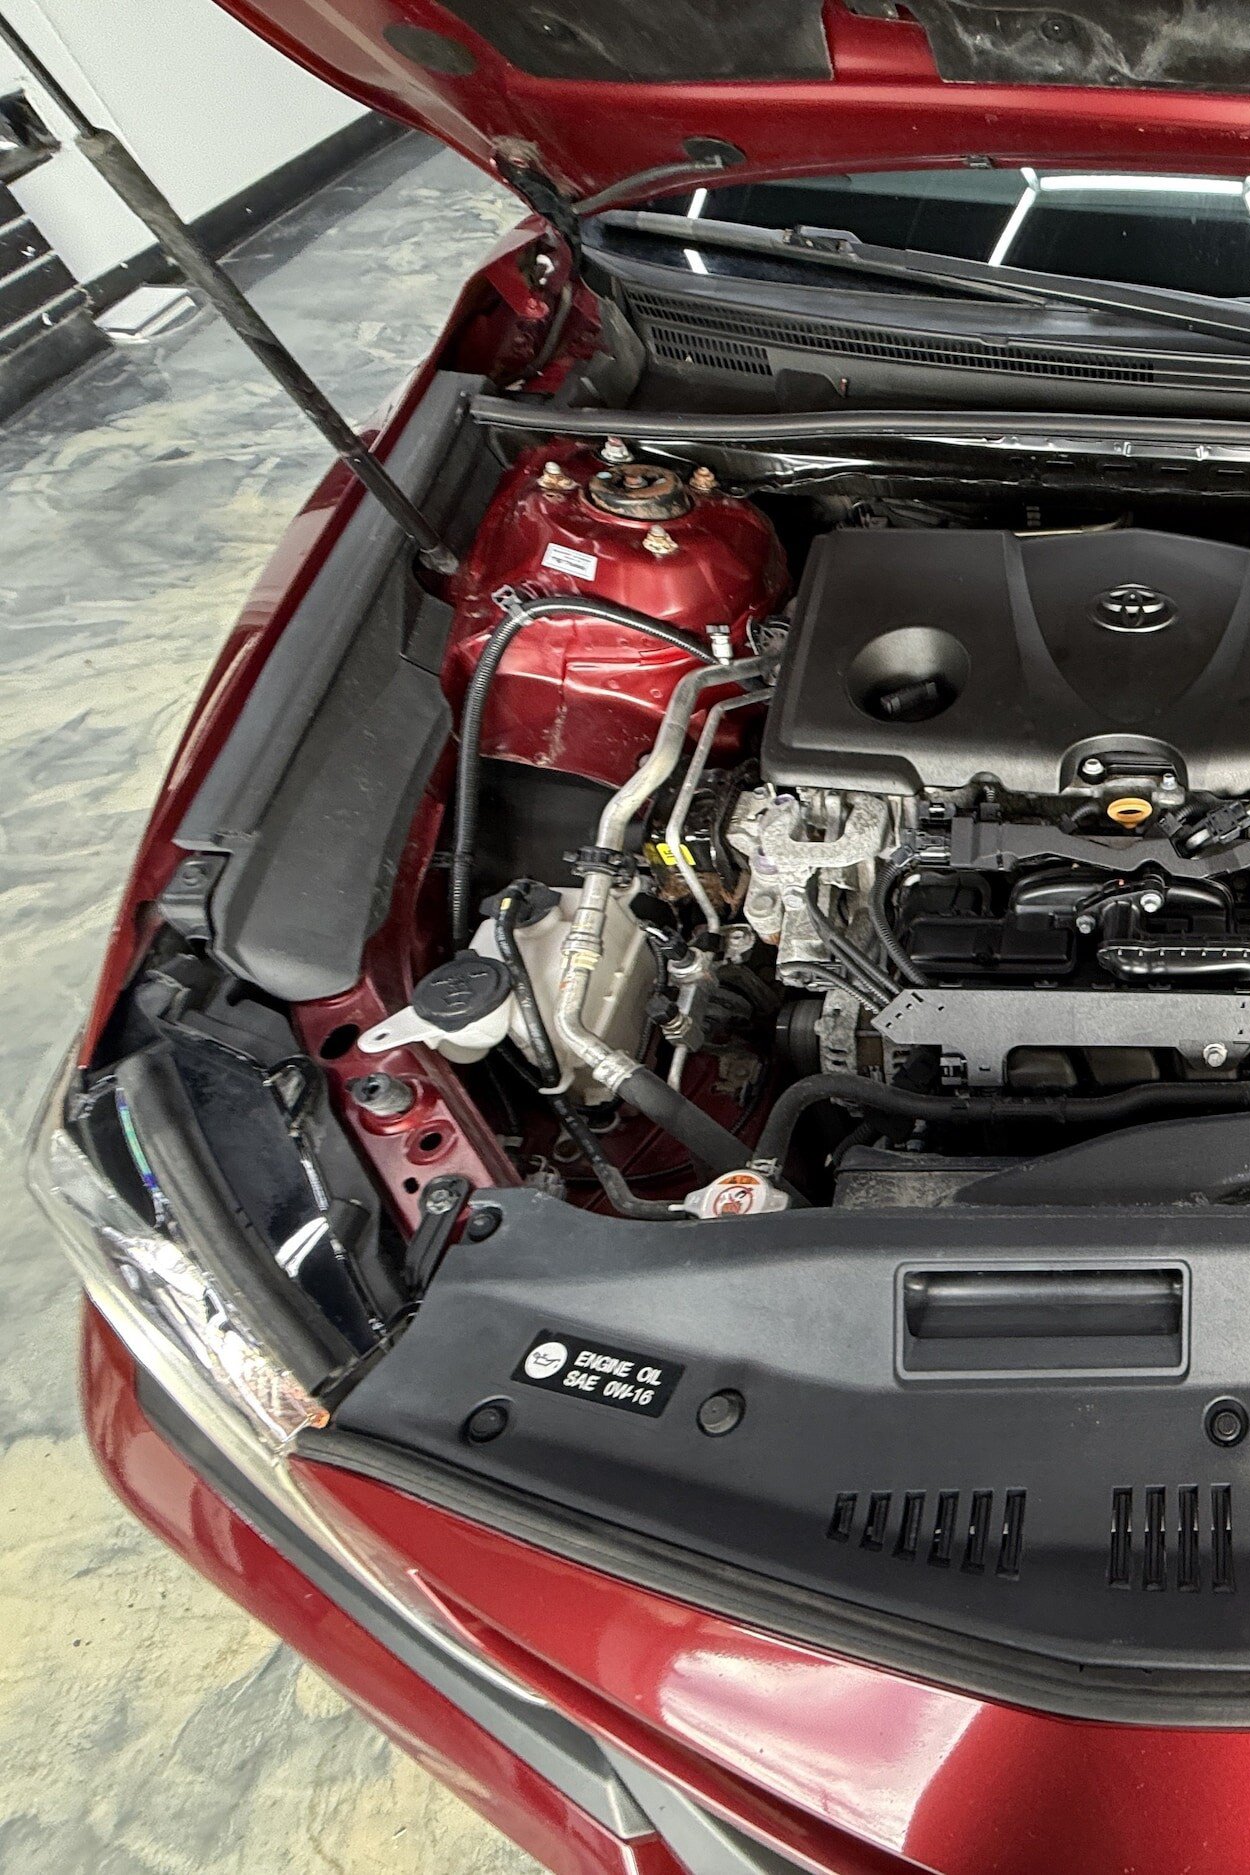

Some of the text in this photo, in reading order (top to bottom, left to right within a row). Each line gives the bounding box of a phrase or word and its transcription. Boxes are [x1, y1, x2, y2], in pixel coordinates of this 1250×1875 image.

[573, 1350, 663, 1386] ENGINE OIL
[562, 1370, 656, 1406] SAE 0W-16
